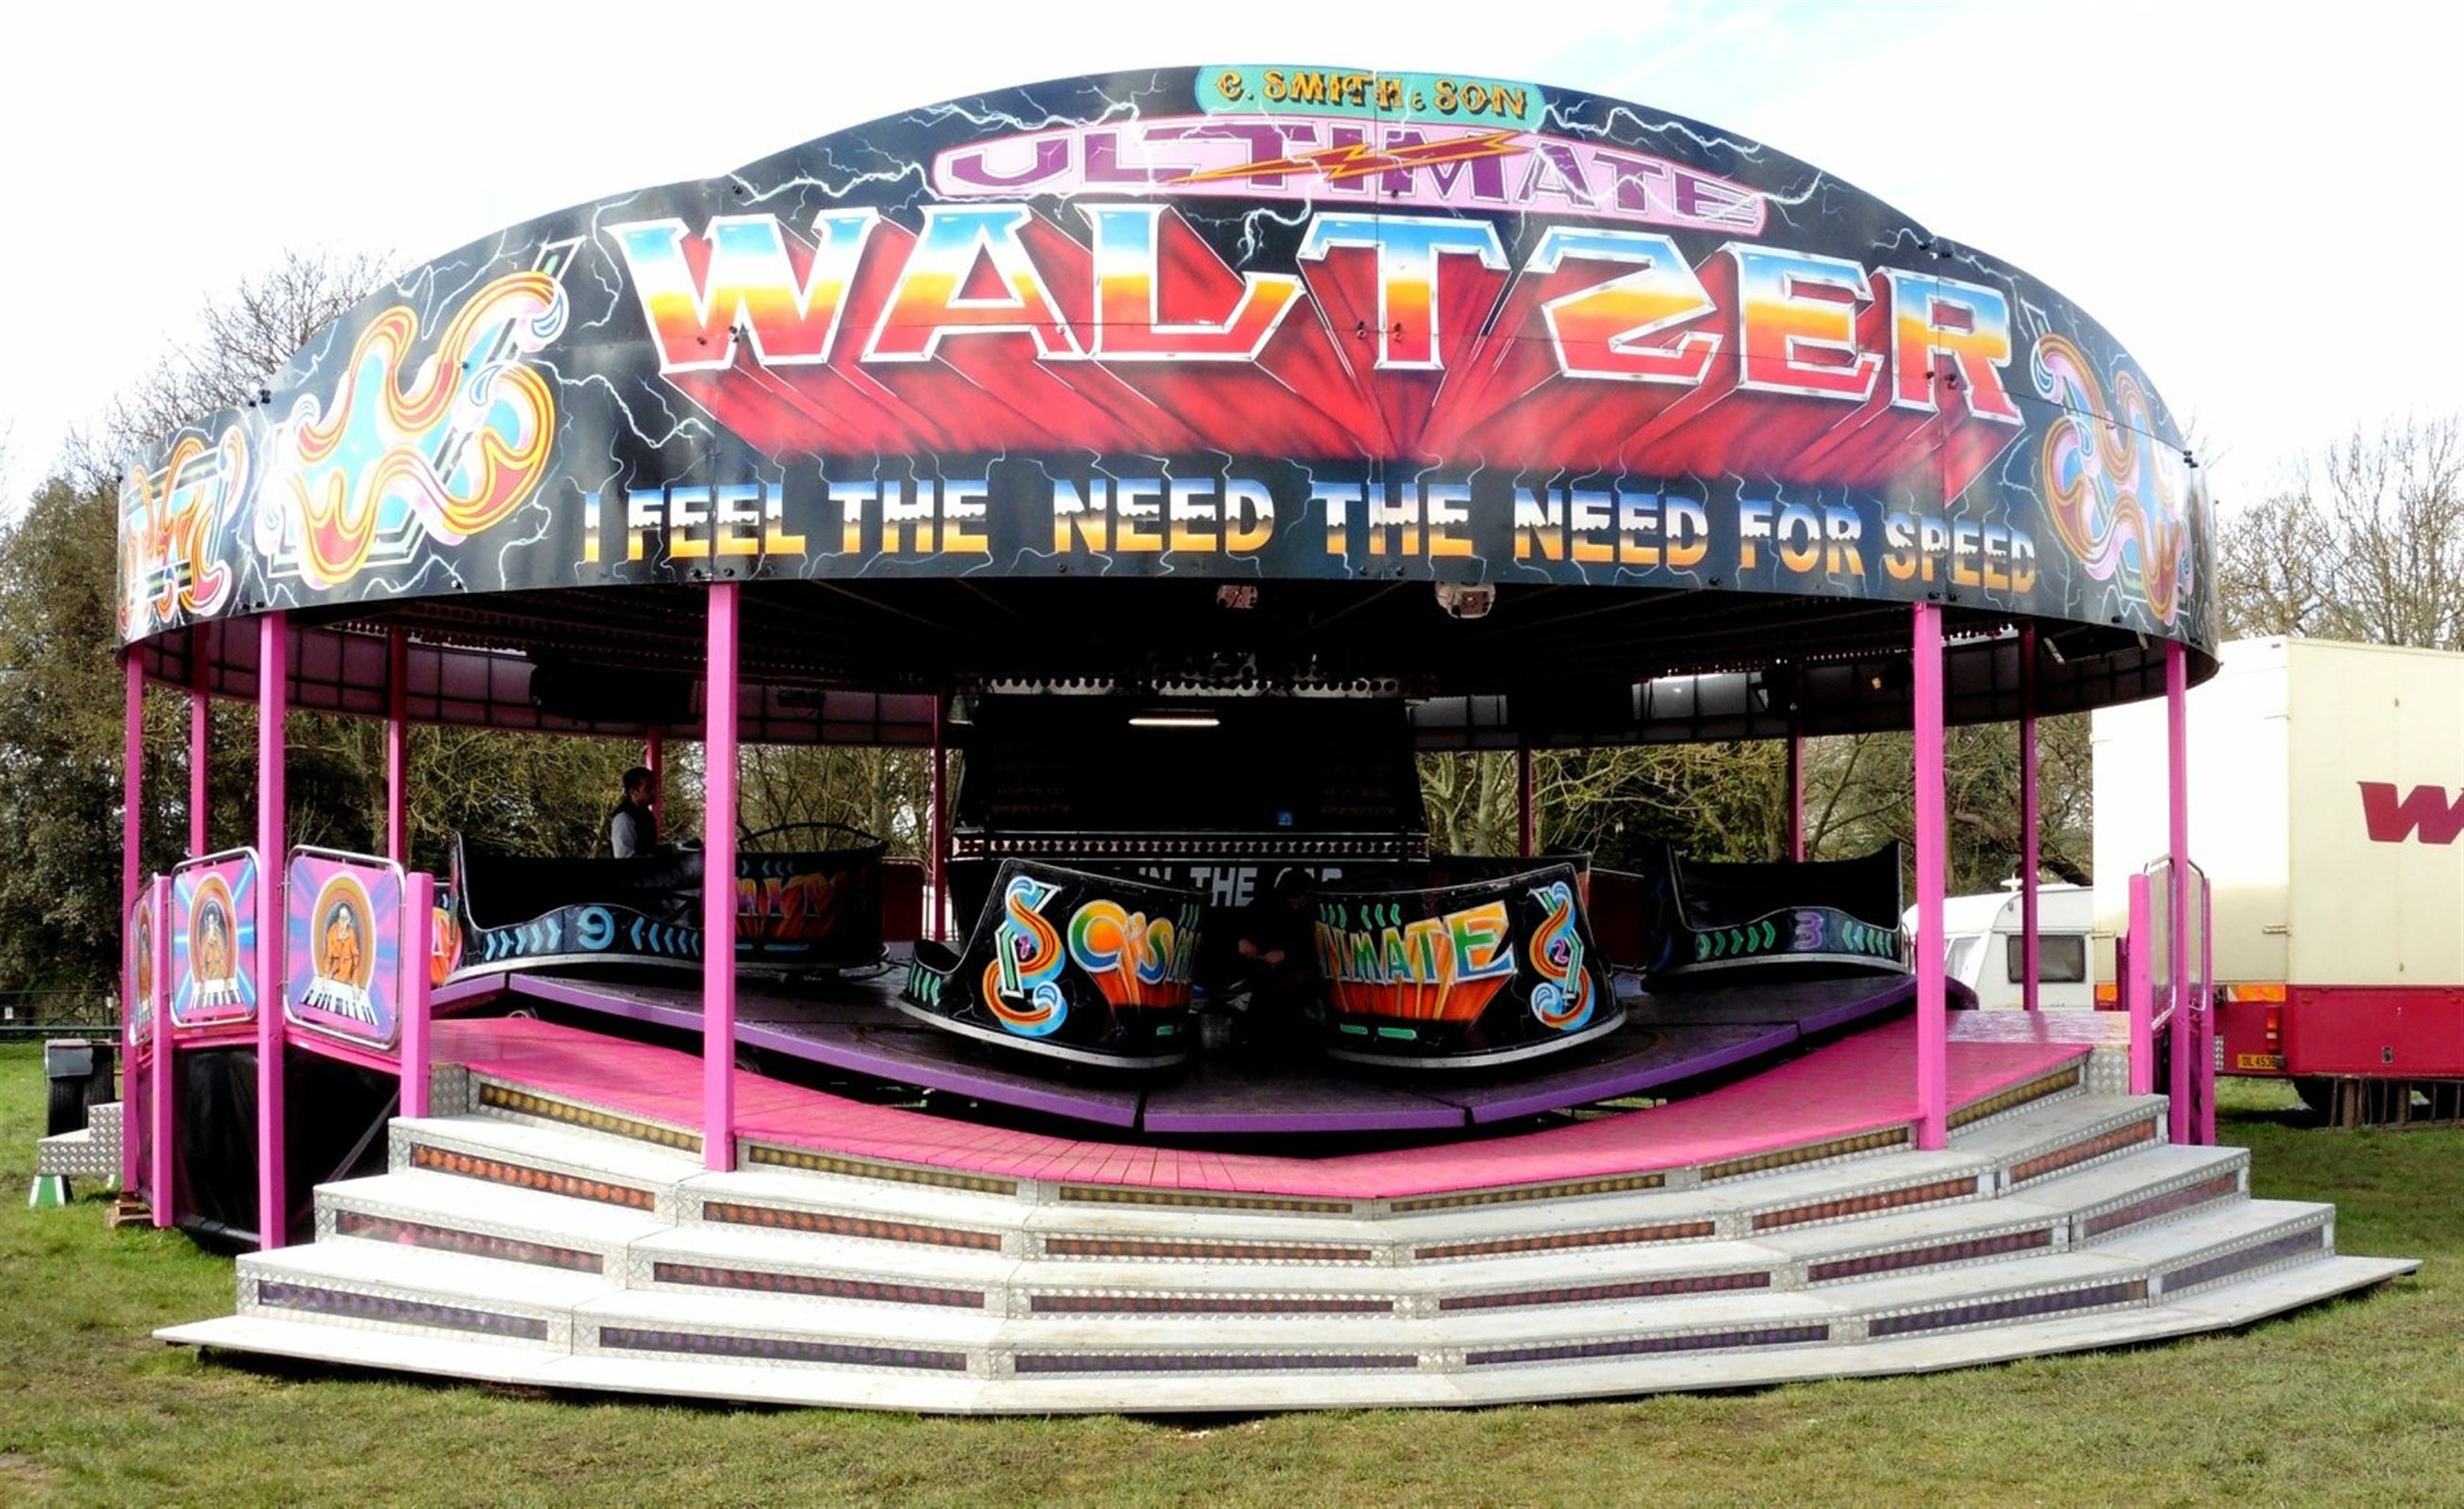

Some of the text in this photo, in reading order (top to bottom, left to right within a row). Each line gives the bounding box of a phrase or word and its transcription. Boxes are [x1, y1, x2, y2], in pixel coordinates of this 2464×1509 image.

[1263, 69, 1405, 108] SMITH
[1433, 77, 1526, 117] SON
[943, 116, 1759, 229] ULTIMATE
[602, 202, 2025, 426] WALTZER
[583, 477, 2038, 594] I FEEL THE NEED THE NEED FOR SPEED
[1190, 867, 1258, 907] THE
[577, 906, 615, 951] 9
[1793, 911, 1824, 951] 3
